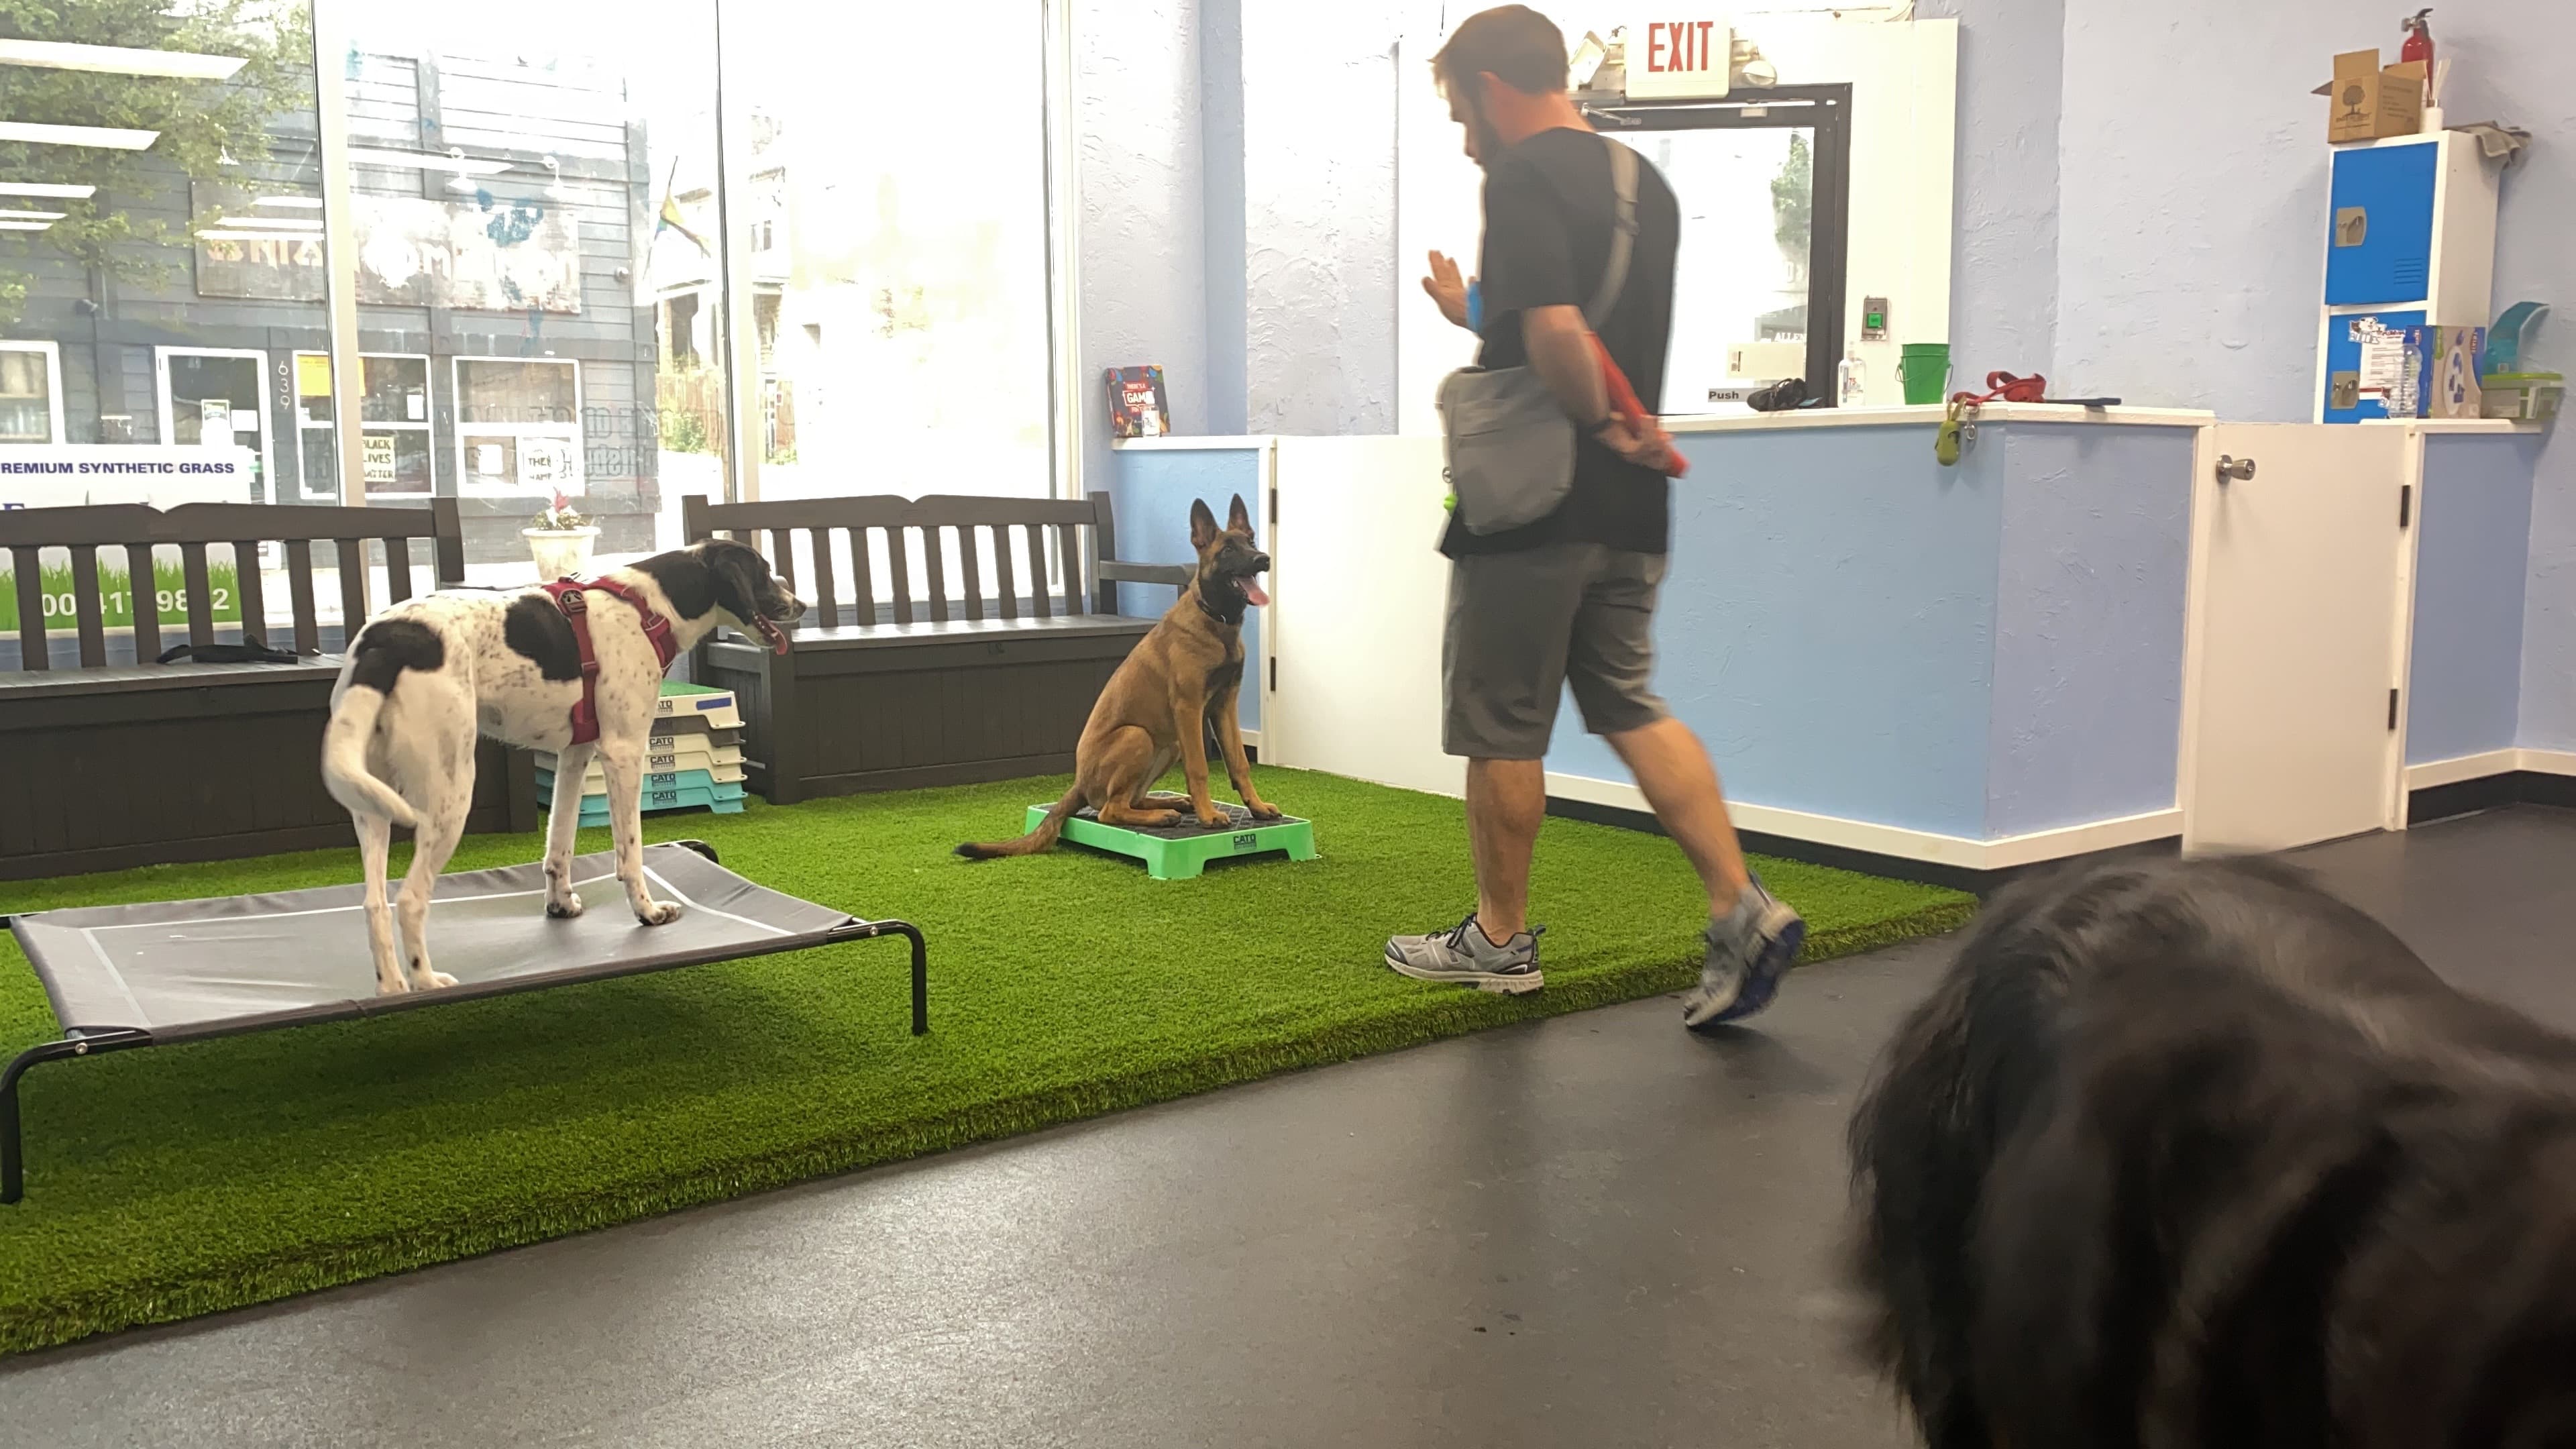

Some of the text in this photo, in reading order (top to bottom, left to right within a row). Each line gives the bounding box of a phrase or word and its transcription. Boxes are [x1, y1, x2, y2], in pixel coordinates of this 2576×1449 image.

[1648, 21, 1713, 72] EXIT
[1126, 392, 1146, 403] GAM
[1709, 390, 1739, 400] Push
[0, 463, 235, 474] REMIUM SYNTHETIC GRASS
[649, 737, 674, 745] CATO
[650, 755, 675, 763] CATO
[651, 773, 676, 782] CATO
[653, 791, 677, 799] CATO
[1234, 834, 1256, 843] CATO
